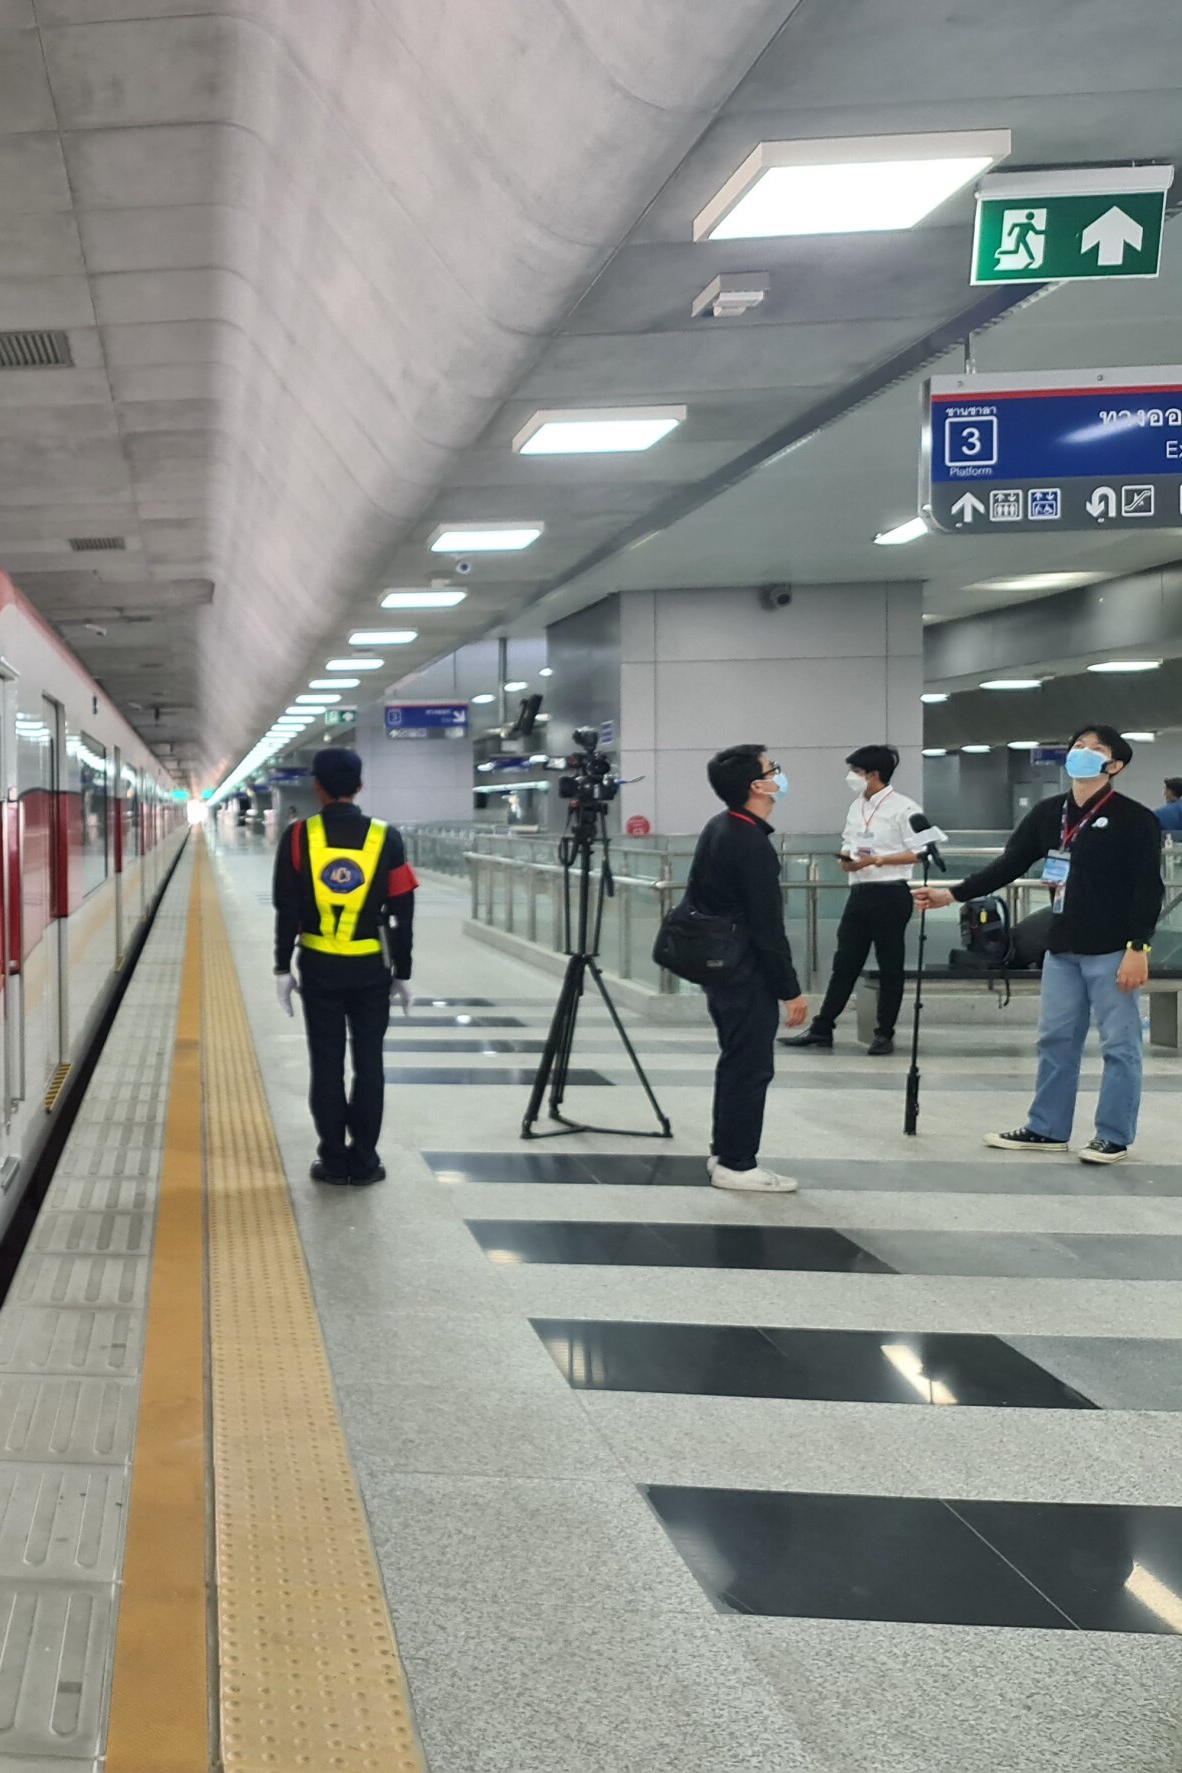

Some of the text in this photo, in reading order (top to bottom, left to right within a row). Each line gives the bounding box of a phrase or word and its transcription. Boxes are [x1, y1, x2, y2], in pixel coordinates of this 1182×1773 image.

[945, 405, 997, 416] ชานชาลา
[961, 427, 981, 455] 3
[949, 467, 993, 476] Platform
